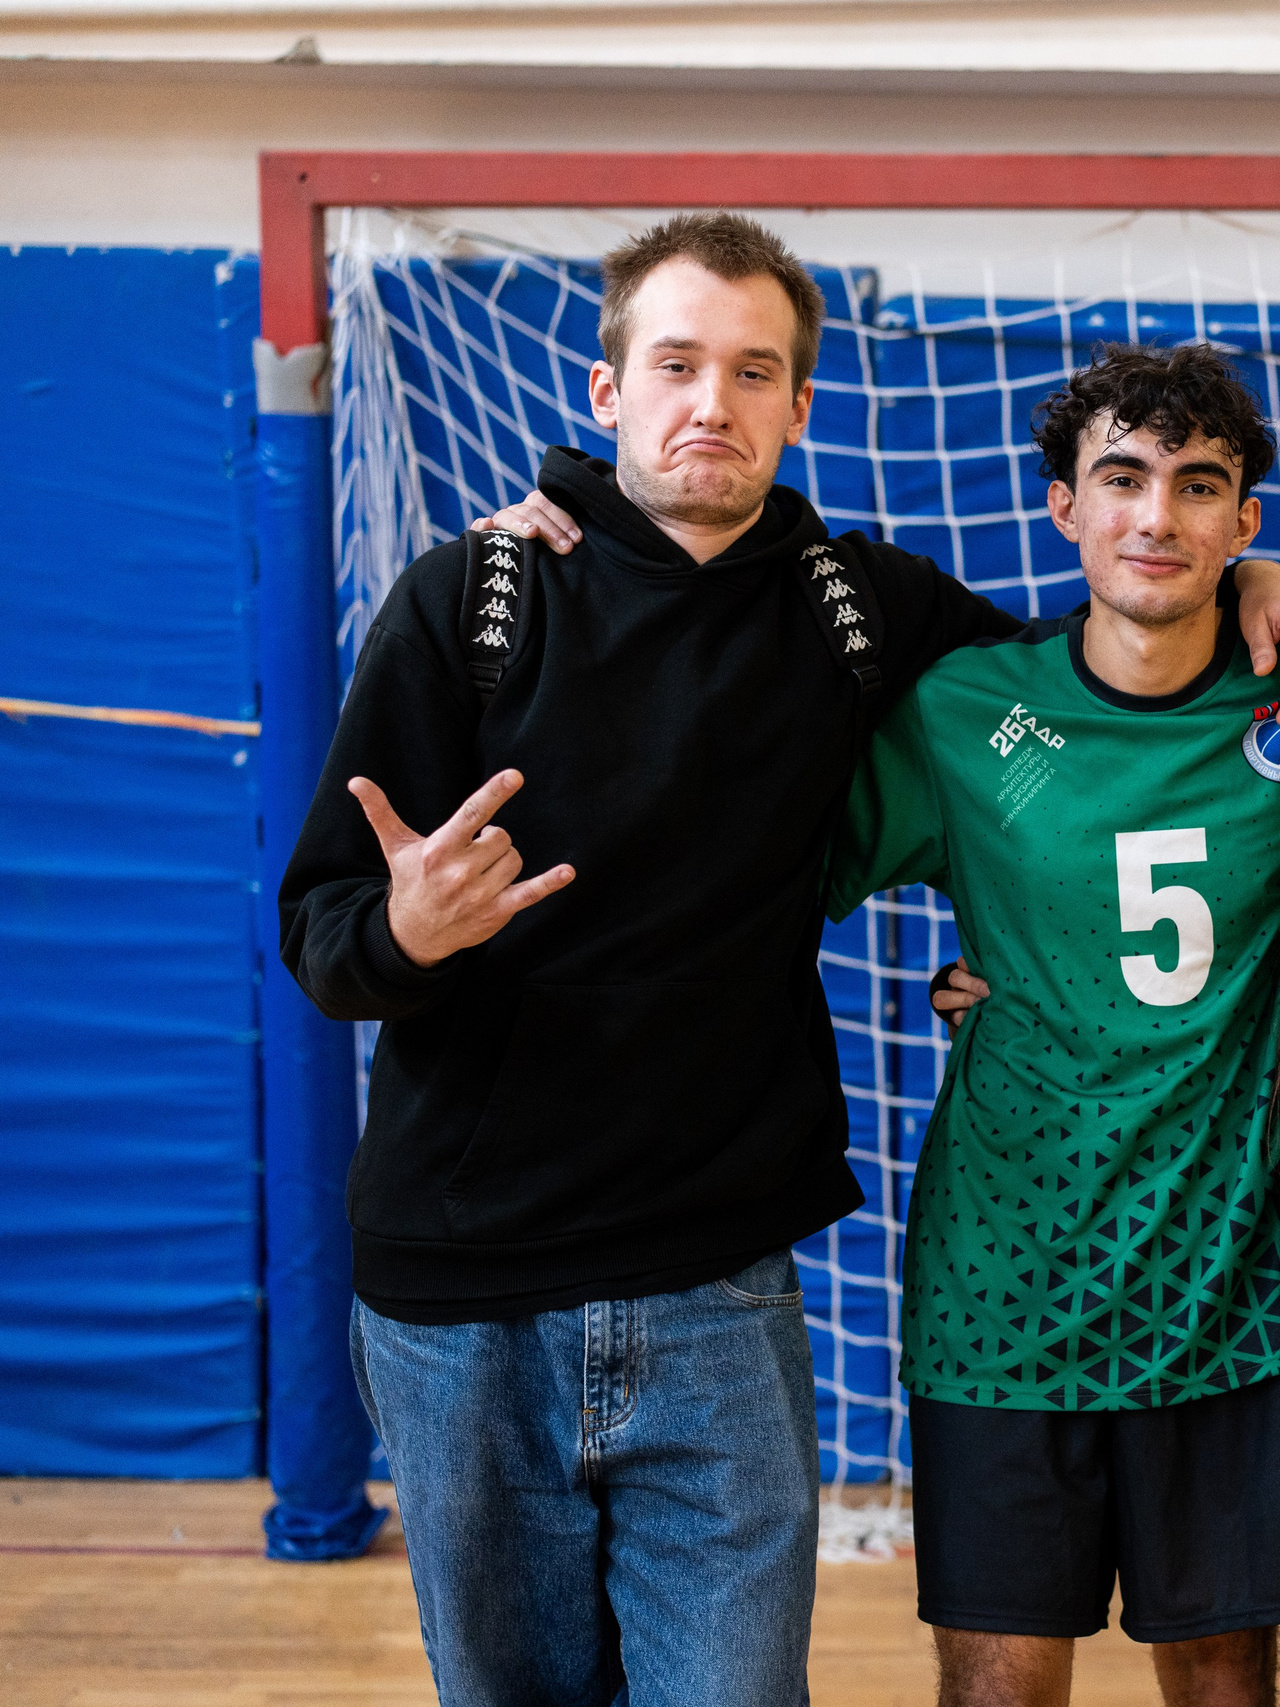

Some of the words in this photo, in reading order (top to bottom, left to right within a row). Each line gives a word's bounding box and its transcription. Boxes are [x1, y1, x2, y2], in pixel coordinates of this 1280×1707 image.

[988, 716, 1027, 758] 26
[1009, 703, 1066, 750] КАДР
[996, 751, 1043, 804] АРХИТЕКТУРЫ
[1001, 744, 1035, 783] КОЛЛЕДЖ
[1040, 758, 1050, 769] И
[1115, 827, 1215, 1006] 5
